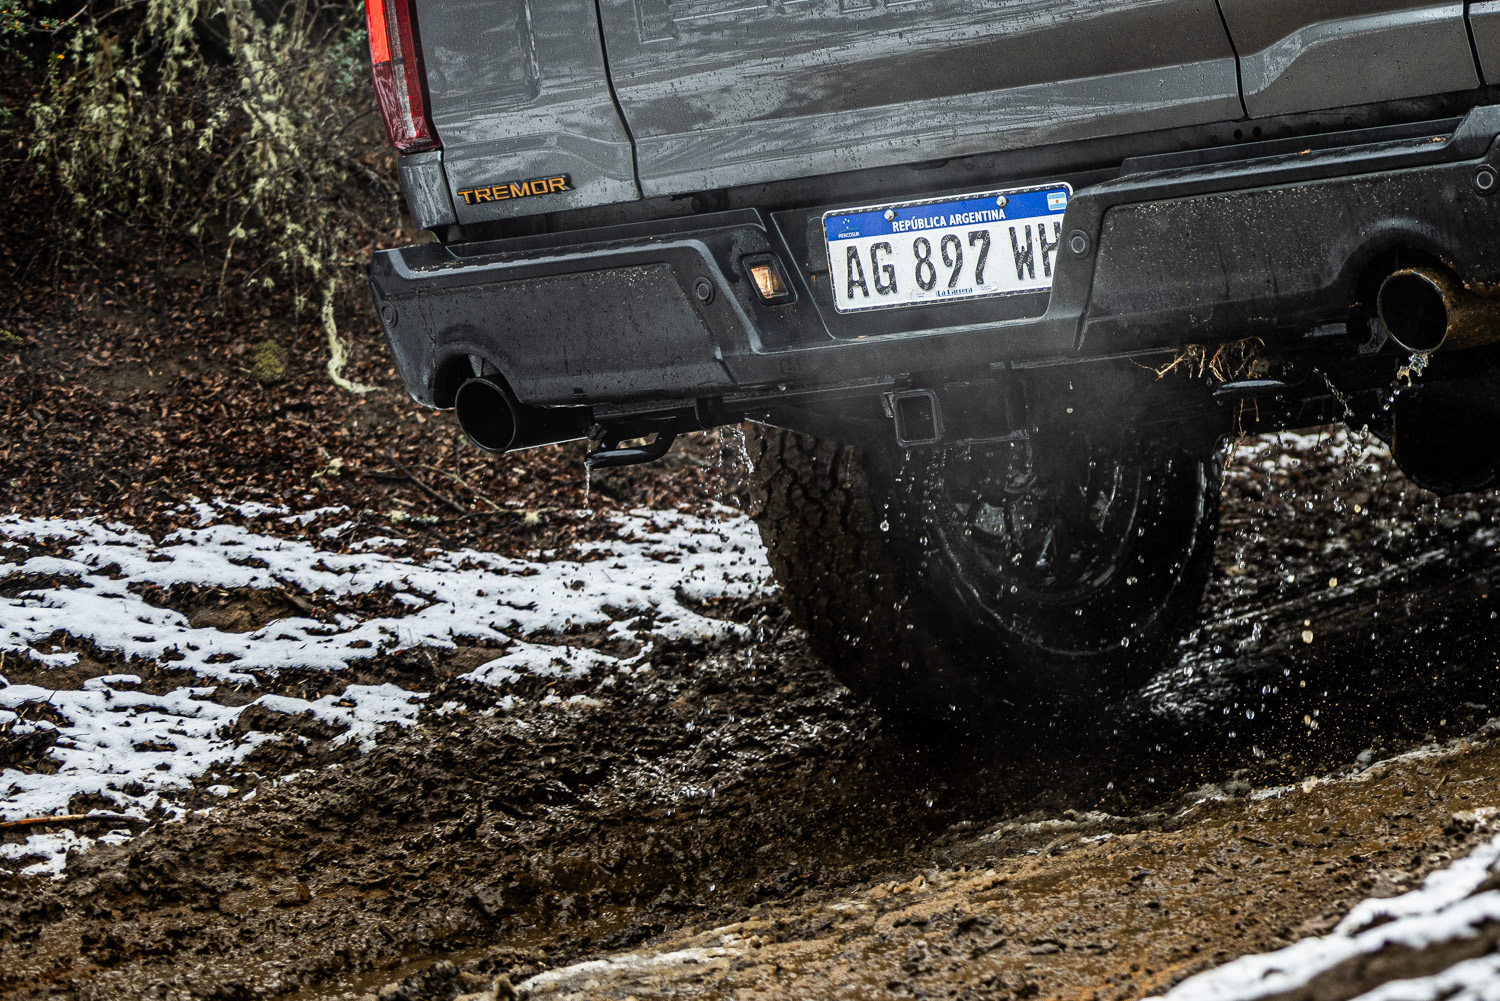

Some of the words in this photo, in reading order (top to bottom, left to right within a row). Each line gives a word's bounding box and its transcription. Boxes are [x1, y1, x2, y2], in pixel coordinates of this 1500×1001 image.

[457, 177, 569, 205] TREMOR
[892, 216, 947, 232] REPÚBLICA
[949, 209, 1006, 225] ARGENTINA
[846, 241, 897, 299] AG
[913, 229, 992, 292] 897
